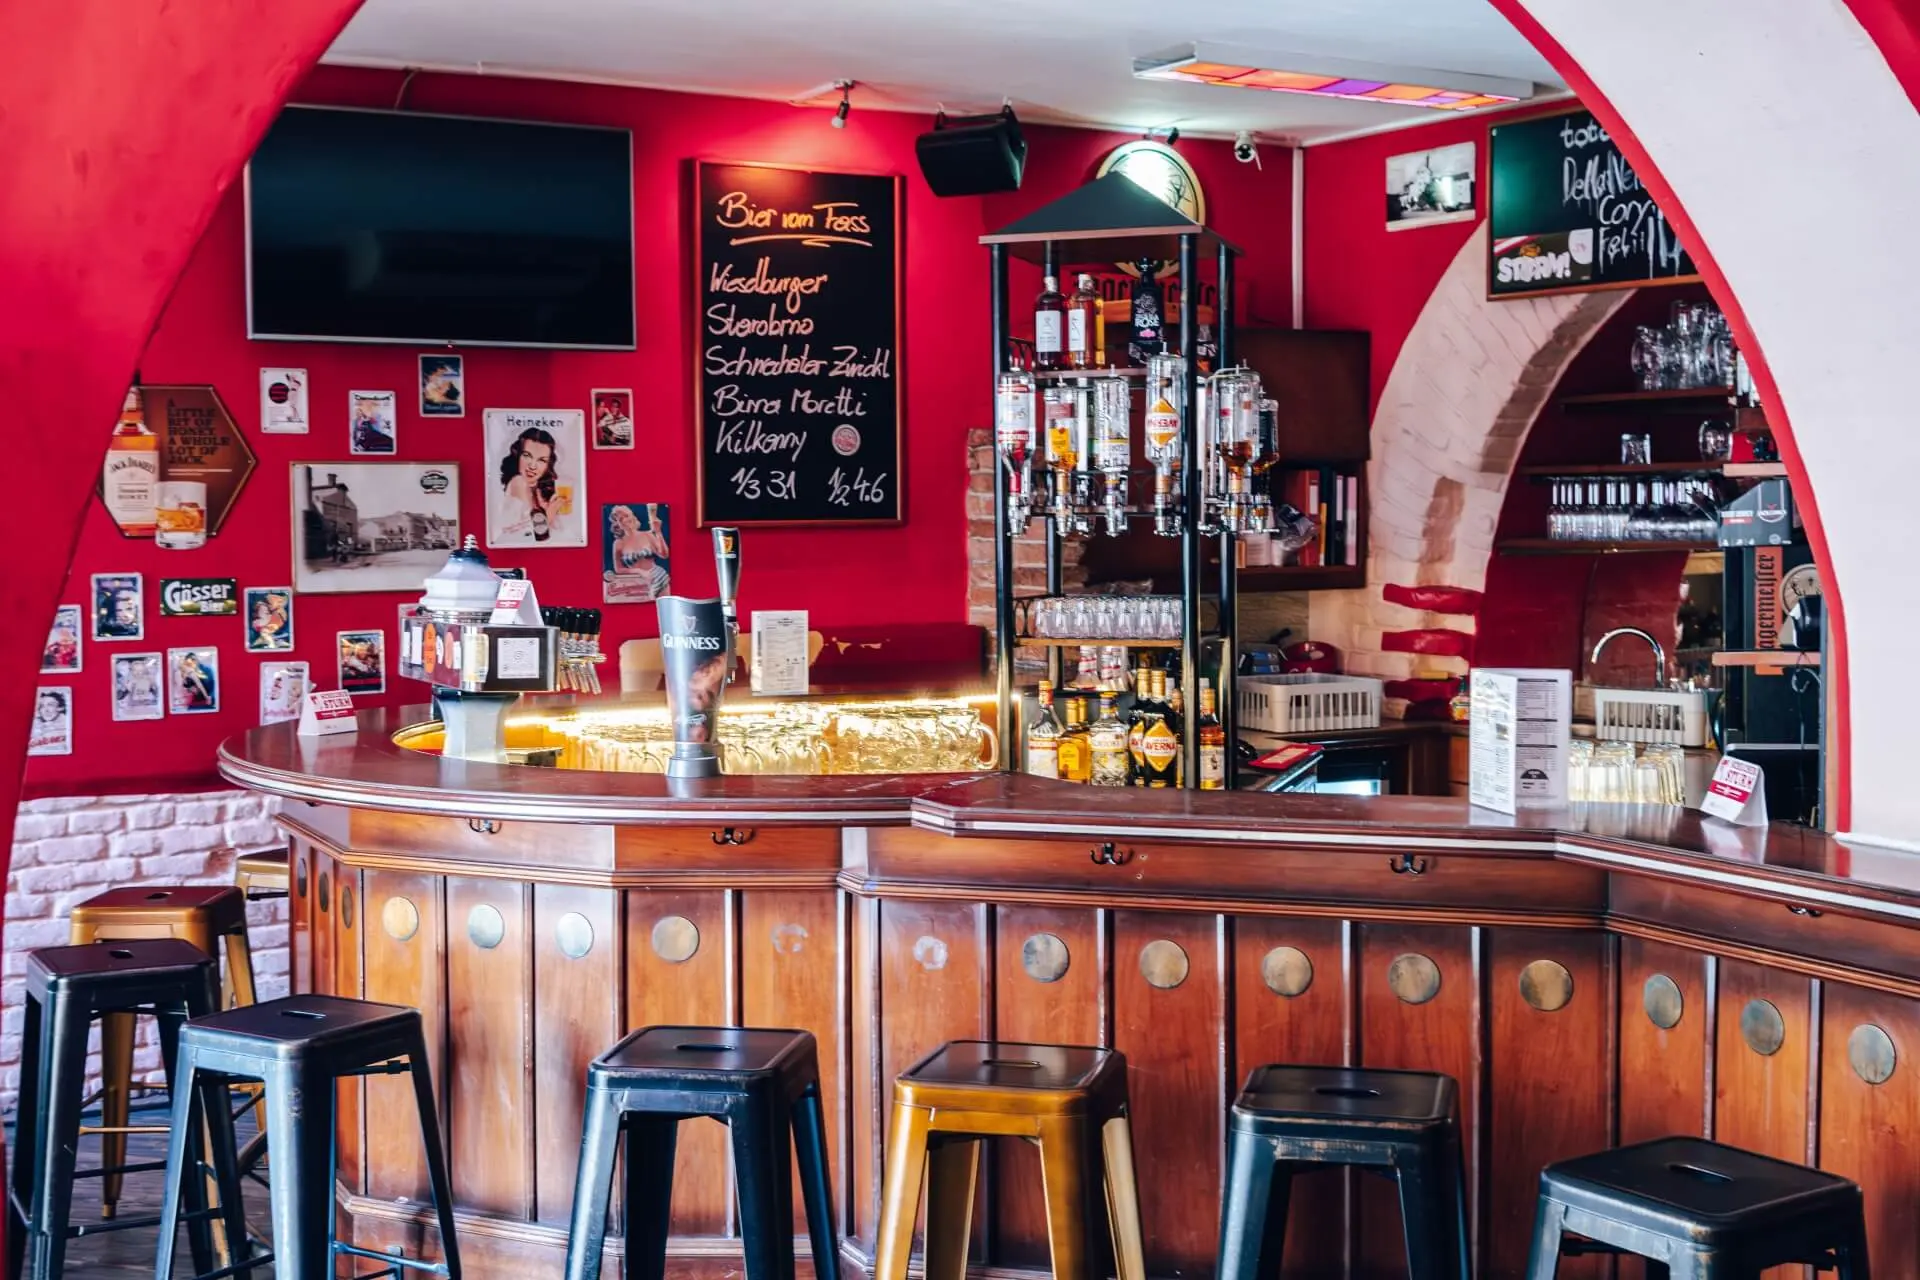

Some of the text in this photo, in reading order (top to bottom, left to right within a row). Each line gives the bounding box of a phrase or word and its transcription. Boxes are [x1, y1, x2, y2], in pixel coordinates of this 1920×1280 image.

[716, 191, 776, 229] Bier
[812, 202, 872, 234] Fass
[790, 386, 867, 417] Moretti
[506, 415, 564, 428] Heineken
[181, 437, 231, 446] WHOLE
[715, 419, 808, 462] Kilkenny
[164, 580, 232, 612] Gösser
[200, 600, 225, 613] Bier
[662, 632, 721, 651] GUINNESS
